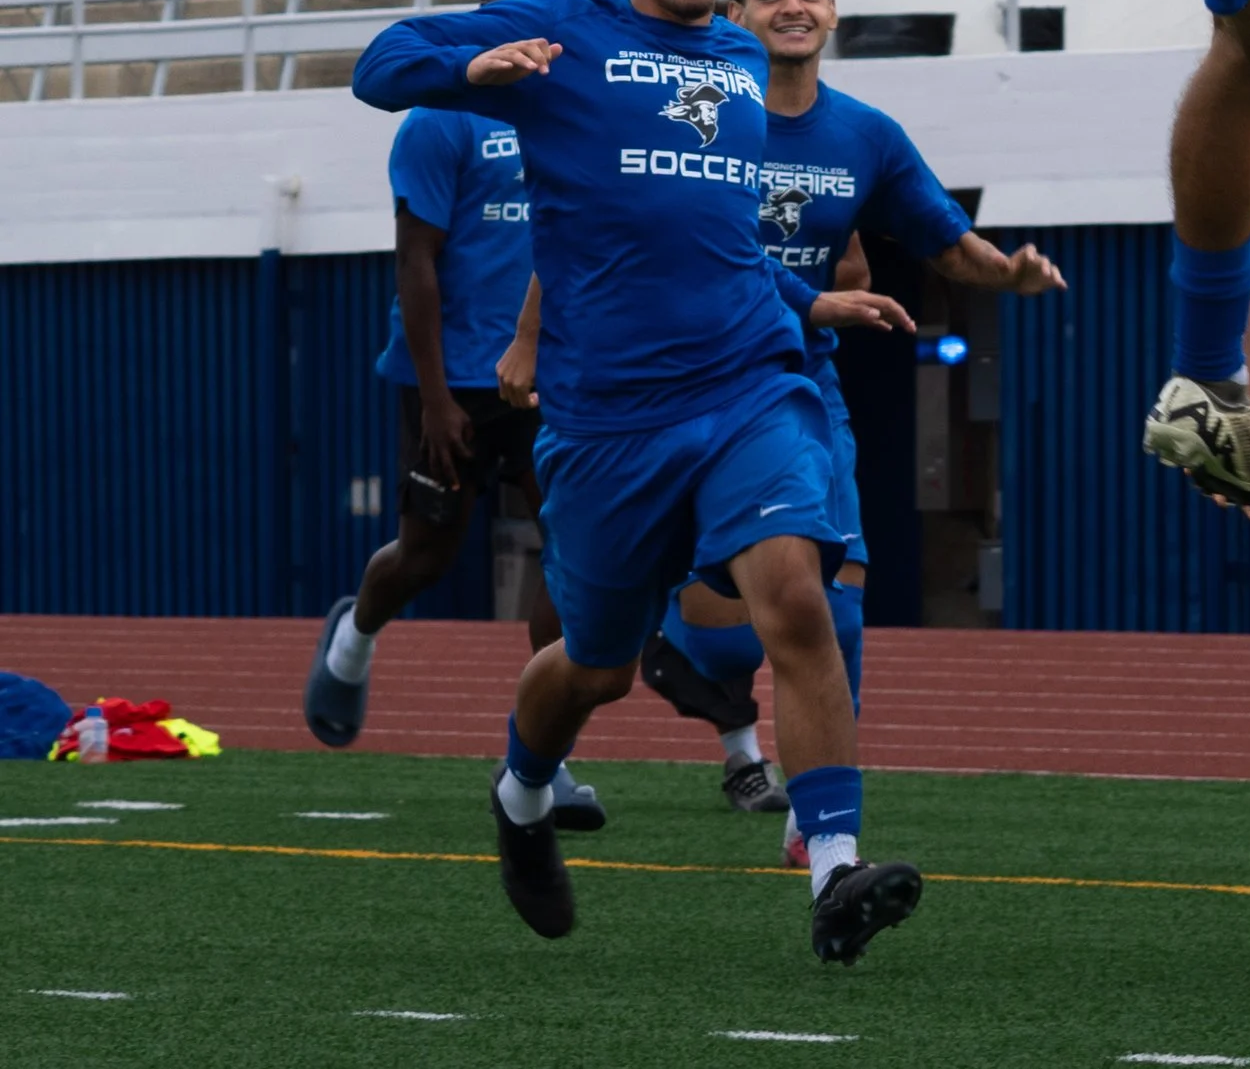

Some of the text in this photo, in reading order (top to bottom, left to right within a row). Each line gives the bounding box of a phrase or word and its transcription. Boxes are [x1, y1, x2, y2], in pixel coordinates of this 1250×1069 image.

[618, 50, 663, 61] SANTA
[667, 54, 713, 68] MONICA
[605, 58, 764, 106] CORSAIRS
[620, 148, 758, 189] SOCCER
[806, 165, 848, 175] COLLEGE
